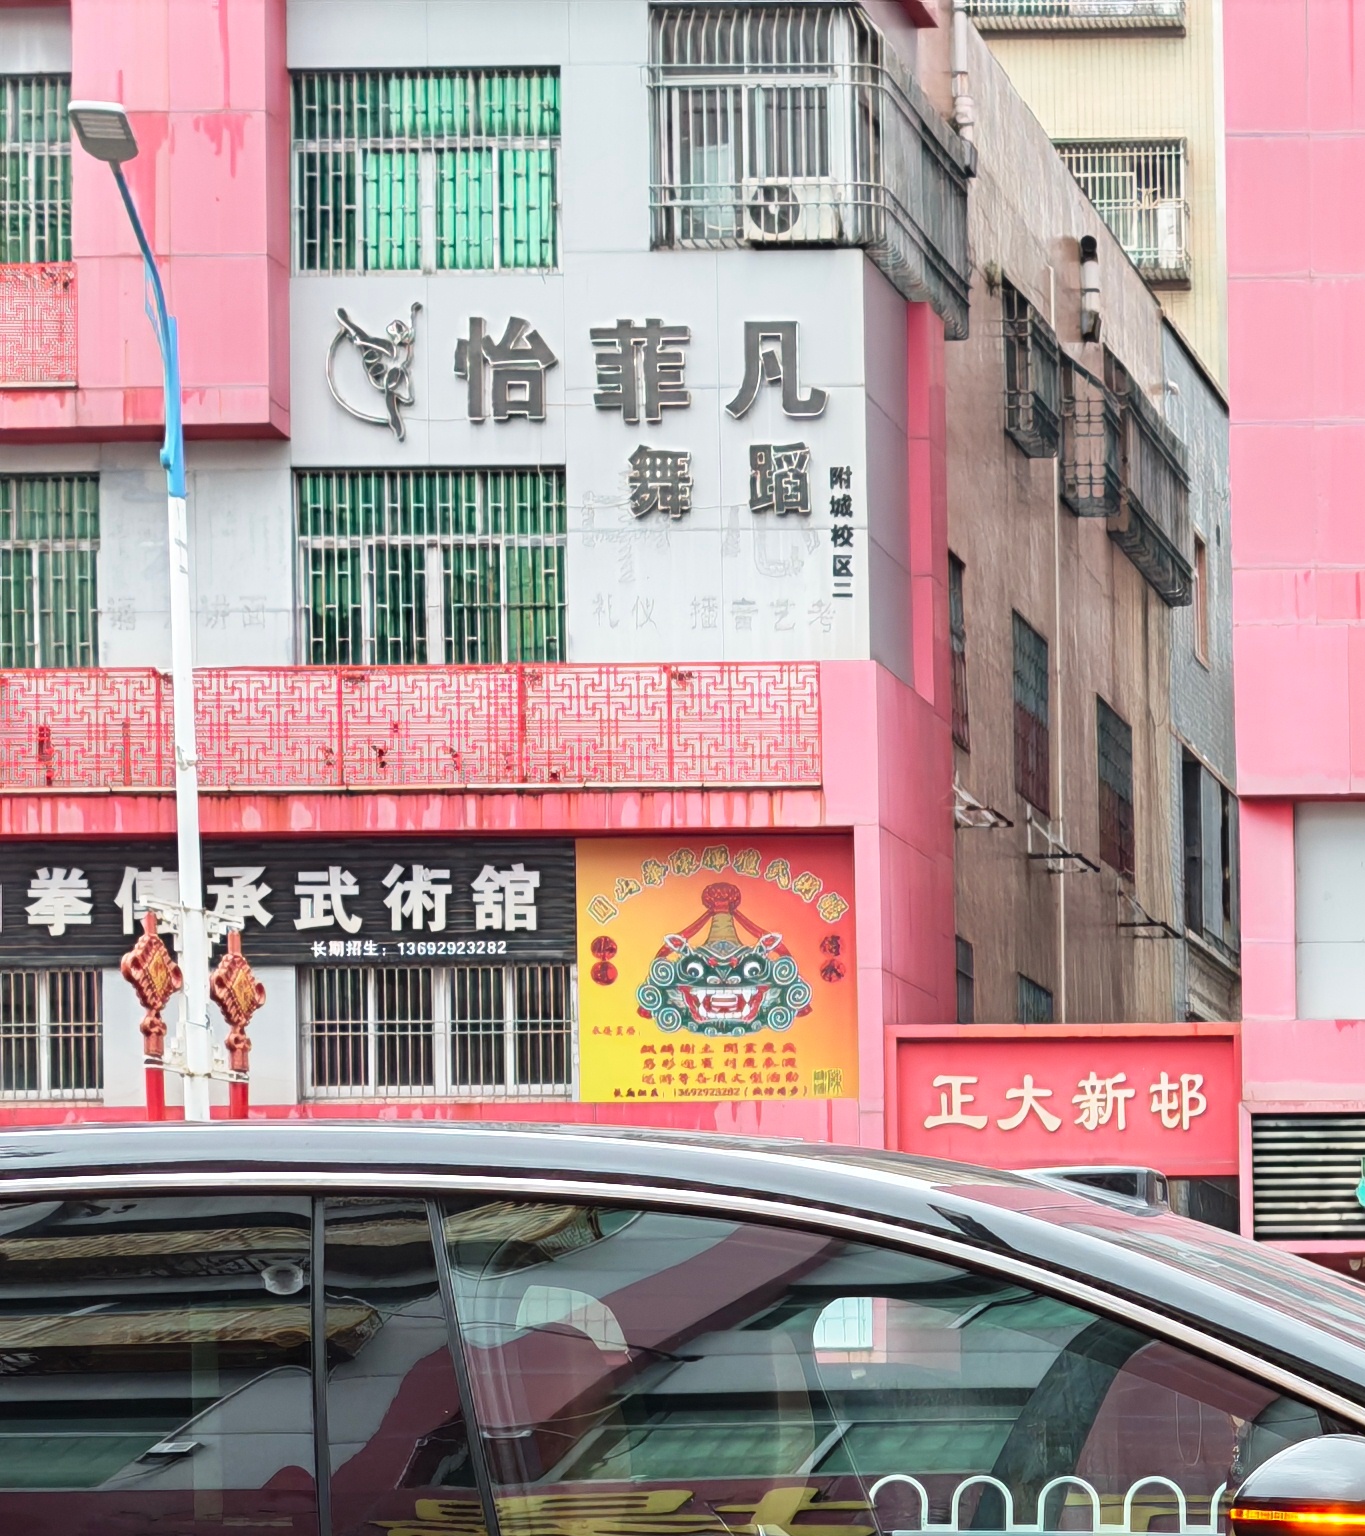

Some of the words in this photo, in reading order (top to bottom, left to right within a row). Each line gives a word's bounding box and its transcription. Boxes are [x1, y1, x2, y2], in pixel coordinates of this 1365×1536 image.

[454, 316, 829, 424] 怡菲凡
[627, 442, 812, 519] 舞蹈
[0, 866, 541, 936] 拳傳承武術館
[397, 940, 508, 956] 13692923282
[923, 1070, 1208, 1132] 正大新邨
